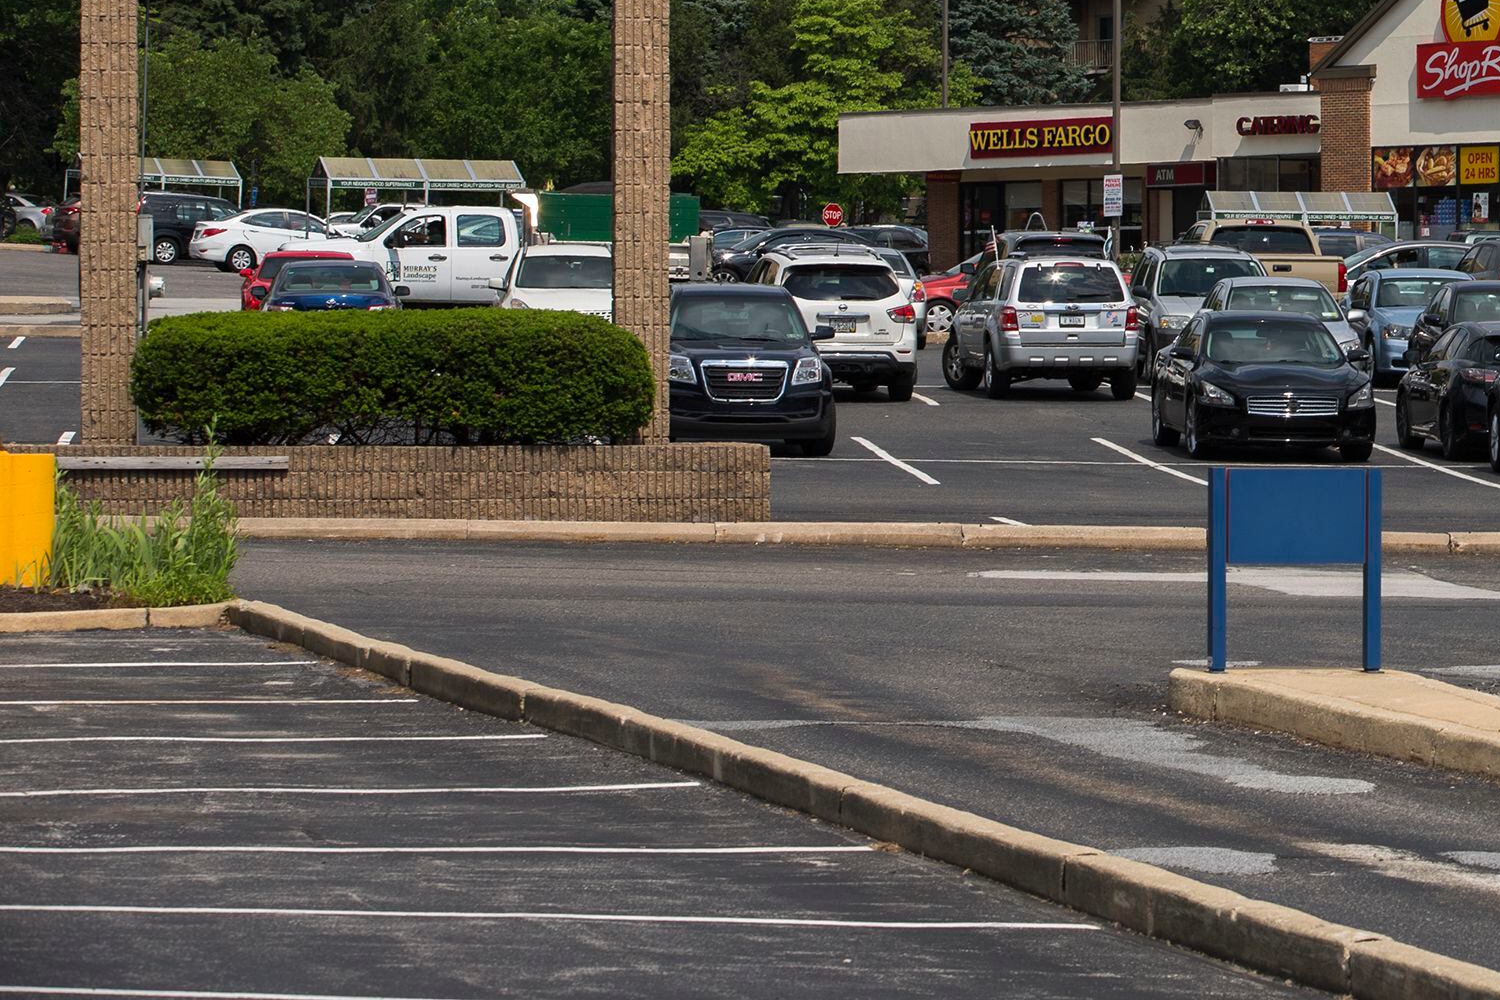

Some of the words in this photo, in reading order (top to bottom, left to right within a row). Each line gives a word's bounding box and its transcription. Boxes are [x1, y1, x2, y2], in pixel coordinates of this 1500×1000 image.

[1236, 115, 1321, 136] CATERING
[969, 128, 1038, 151] WELLS
[1043, 124, 1110, 148] FARGO
[1468, 152, 1492, 164] OPEN
[1156, 169, 1174, 181] ATM
[1465, 168, 1476, 179] 24
[1478, 167, 1496, 179] HRS
[824, 210, 841, 220] STOP
[728, 372, 763, 382] GMC
